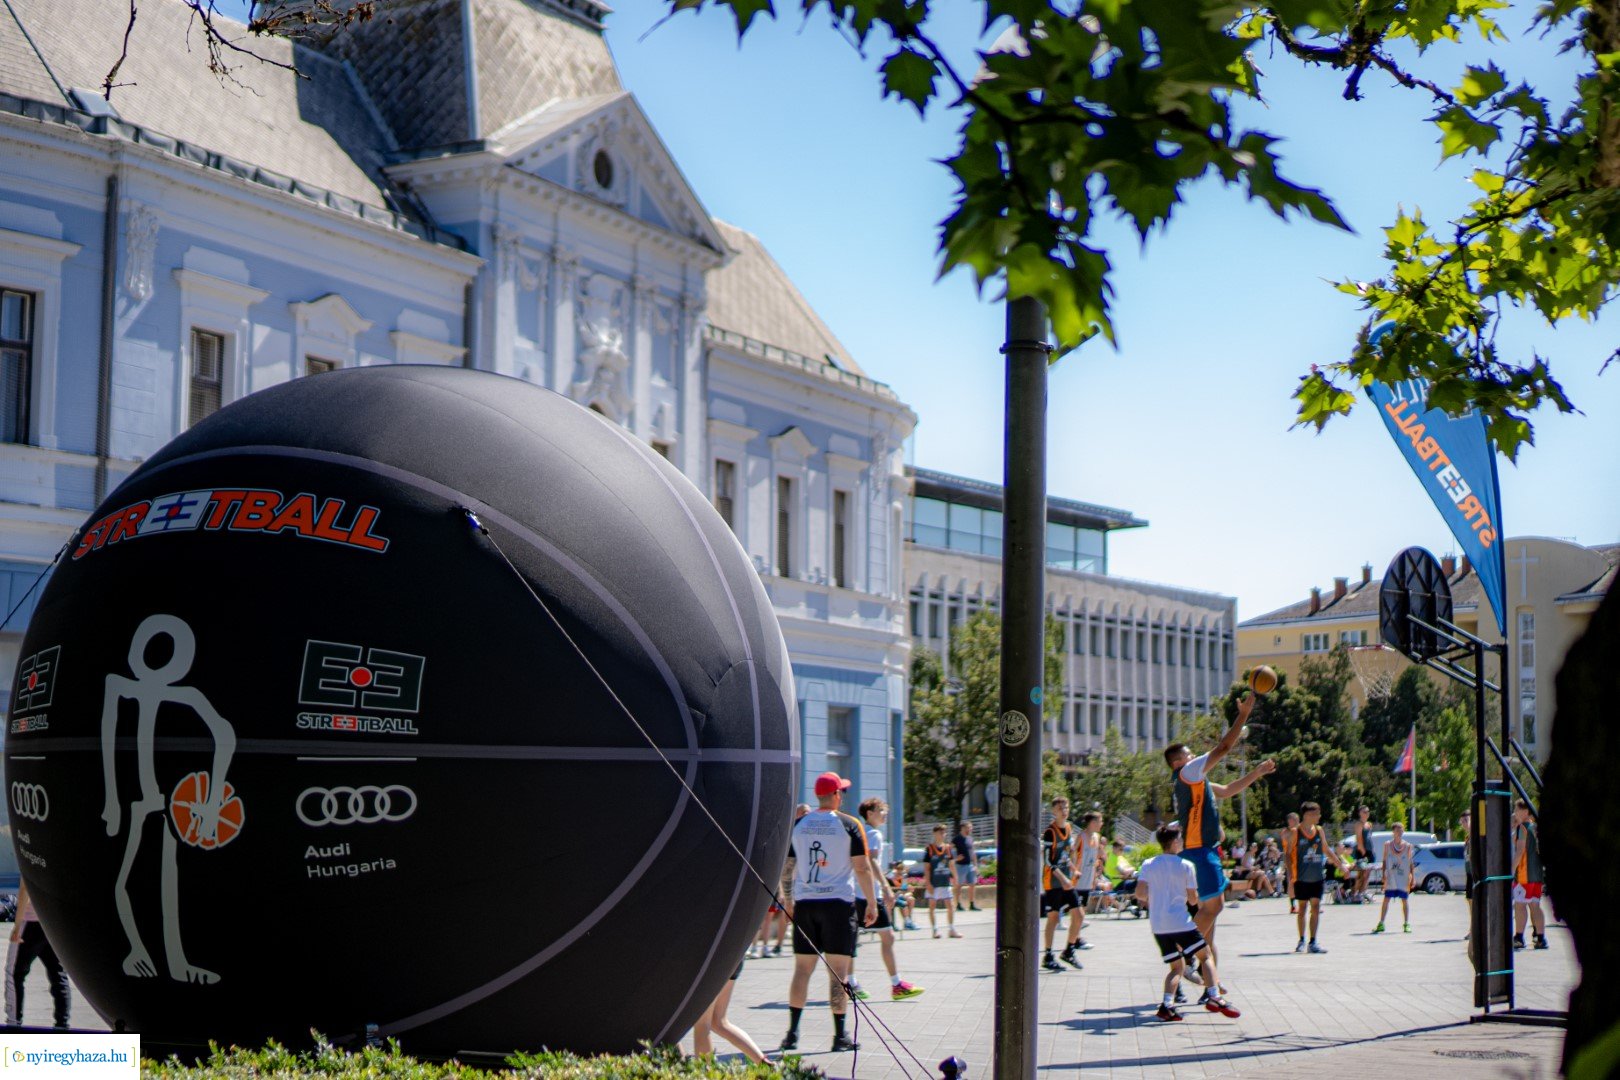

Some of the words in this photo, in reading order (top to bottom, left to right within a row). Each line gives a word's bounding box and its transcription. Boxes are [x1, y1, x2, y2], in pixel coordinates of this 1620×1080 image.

[72, 488, 390, 560] STREETBALL
[296, 712, 419, 734] STREETBALL
[304, 843, 351, 859] Audi
[307, 858, 397, 878] Hungaria
